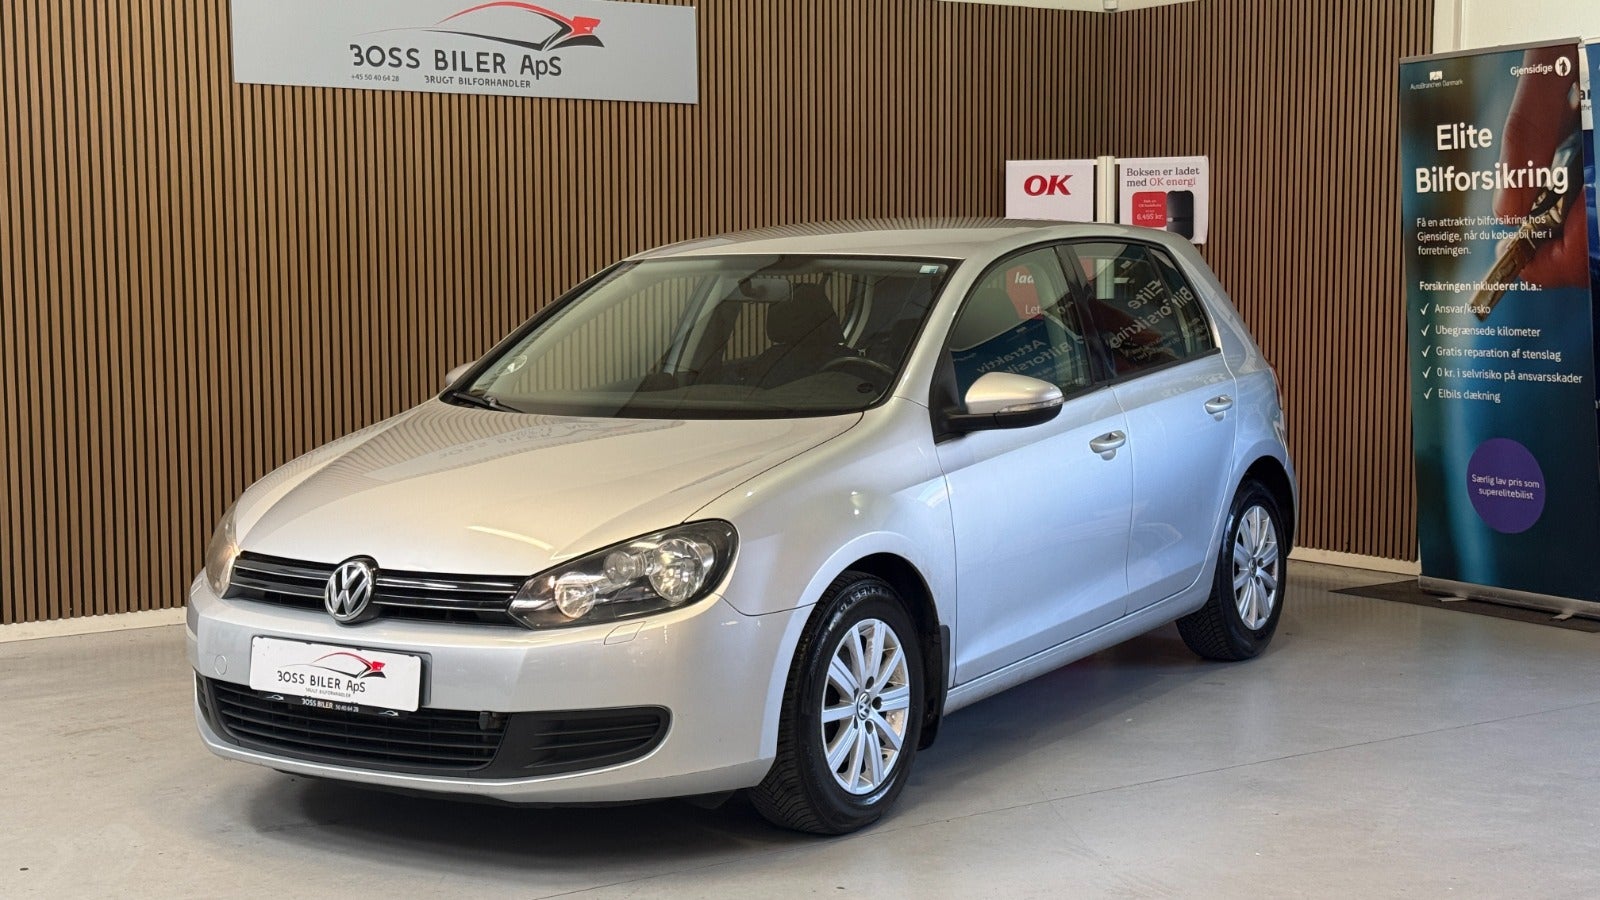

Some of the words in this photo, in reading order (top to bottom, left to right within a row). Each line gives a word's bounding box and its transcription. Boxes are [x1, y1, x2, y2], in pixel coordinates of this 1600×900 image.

[435, 49, 507, 74] BILER
[519, 55, 562, 81] ApS
[1510, 64, 1553, 78] Gjensidige
[458, 77, 531, 88] BILFORHANDLER
[1436, 122, 1493, 151] Elite
[1126, 167, 1161, 177] Boksen
[1175, 166, 1200, 176] ladet
[1415, 160, 1569, 195] Bilforsikring
[1023, 174, 1073, 197] OK
[1126, 178, 1147, 187] med
[1149, 178, 1165, 187] OK
[1166, 177, 1196, 188] energi
[1416, 217, 1426, 228] Få
[1439, 217, 1476, 227] attraktiv
[1477, 215, 1527, 227] bilforsikring
[1528, 215, 1546, 225] hos
[1417, 232, 1462, 243] Gjensidige,
[1464, 230, 1478, 240] når
[1480, 230, 1490, 240] du
[1491, 230, 1517, 240] køber
[1519, 229, 1529, 239] bil
[1531, 229, 1546, 239] her
[1418, 246, 1472, 258] forretningen.
[1419, 281, 1472, 293] Forsikringen
[1473, 281, 1518, 292] inkluderer
[1434, 303, 1491, 314] Ansvar/kasko
[1435, 325, 1495, 338] Ubegrænsede
[1497, 326, 1541, 338] kilometer
[1436, 346, 1462, 357] Gratis
[1464, 348, 1509, 361] reparation
[1511, 348, 1520, 359] af
[1522, 349, 1561, 363] stenslag
[1444, 368, 1456, 378] kr.
[1462, 369, 1502, 380] selvrisiko
[1504, 370, 1516, 382] på
[1517, 371, 1583, 384] ansvarsskader
[1438, 388, 1461, 399] Elbils
[1463, 390, 1501, 404] dækning
[1471, 474, 1494, 486] Særlig
[1495, 475, 1506, 486] lav
[1508, 477, 1523, 488] pris
[1524, 479, 1540, 489] som
[1478, 487, 1534, 500] superelitebilist
[310, 675, 341, 689] BILER
[347, 680, 366, 694] ApS
[317, 700, 334, 710] BILER
